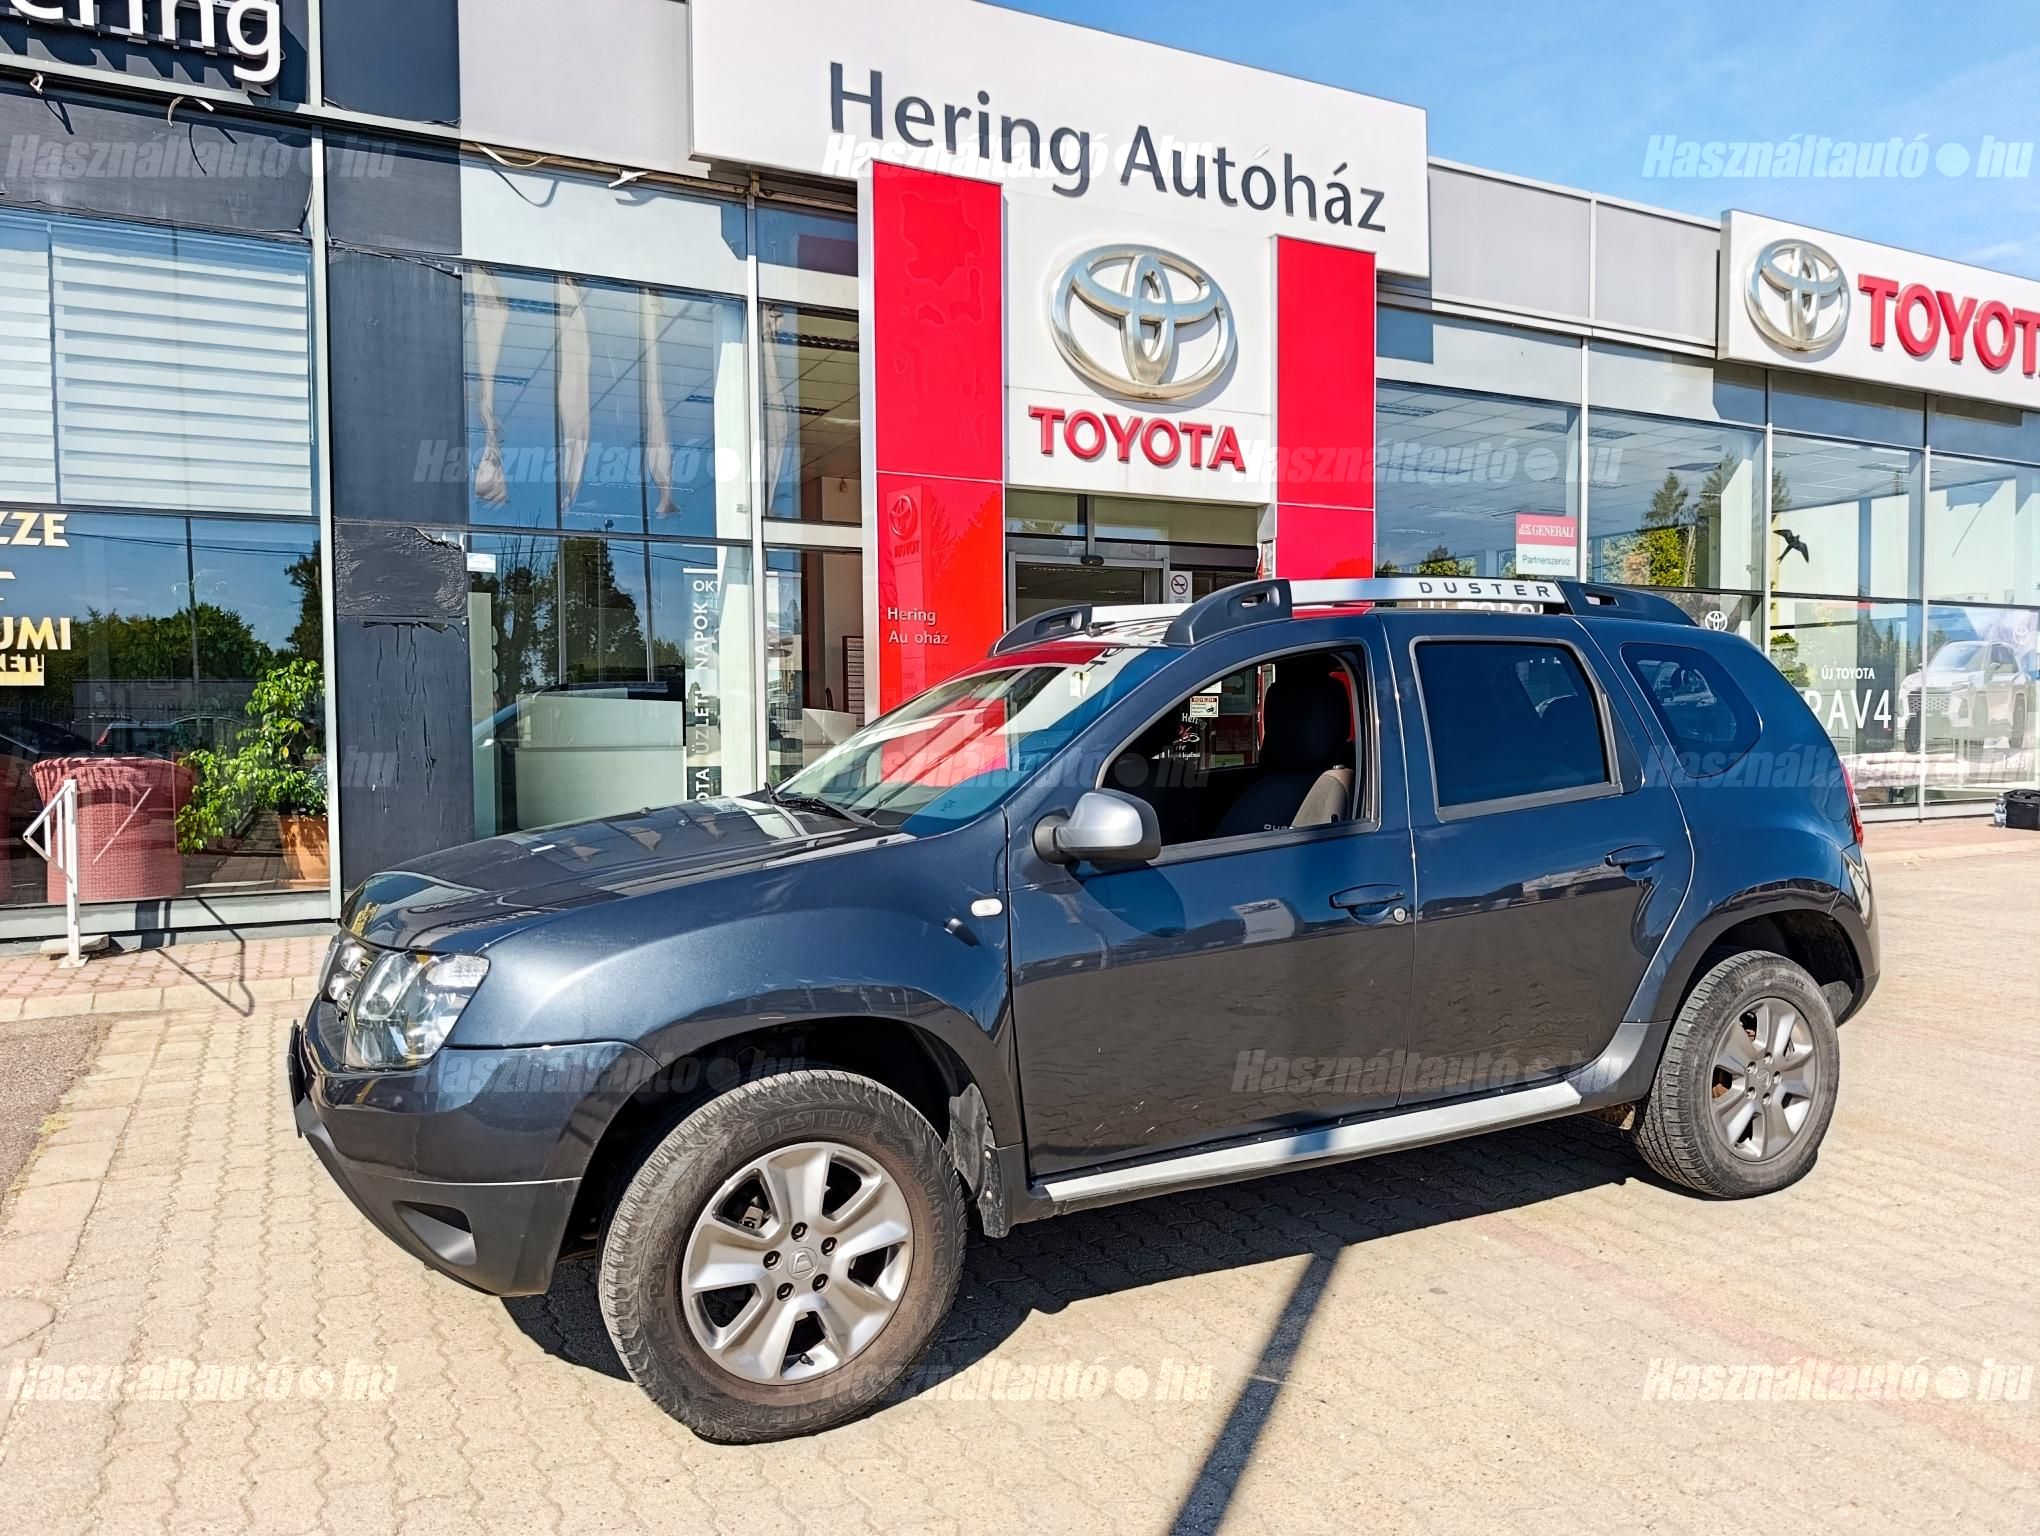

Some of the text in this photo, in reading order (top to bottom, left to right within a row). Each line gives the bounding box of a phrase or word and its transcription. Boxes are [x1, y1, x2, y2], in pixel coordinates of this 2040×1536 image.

[830, 61, 1387, 233] Hering Autóház
[1858, 273, 2040, 378] TOYOT
[1028, 405, 1246, 473] TOYOTA
[1532, 524, 1574, 538] GENERALI
[1522, 554, 1571, 567] Partnerszerviz
[1419, 582, 1551, 598] DUSTER
[887, 607, 936, 626] Hering
[693, 602, 710, 669] NAPOK
[0, 654, 43, 673] ET!
[1821, 665, 1876, 681] ÚJ TOYOTA
[1803, 689, 1892, 730] RAV4
